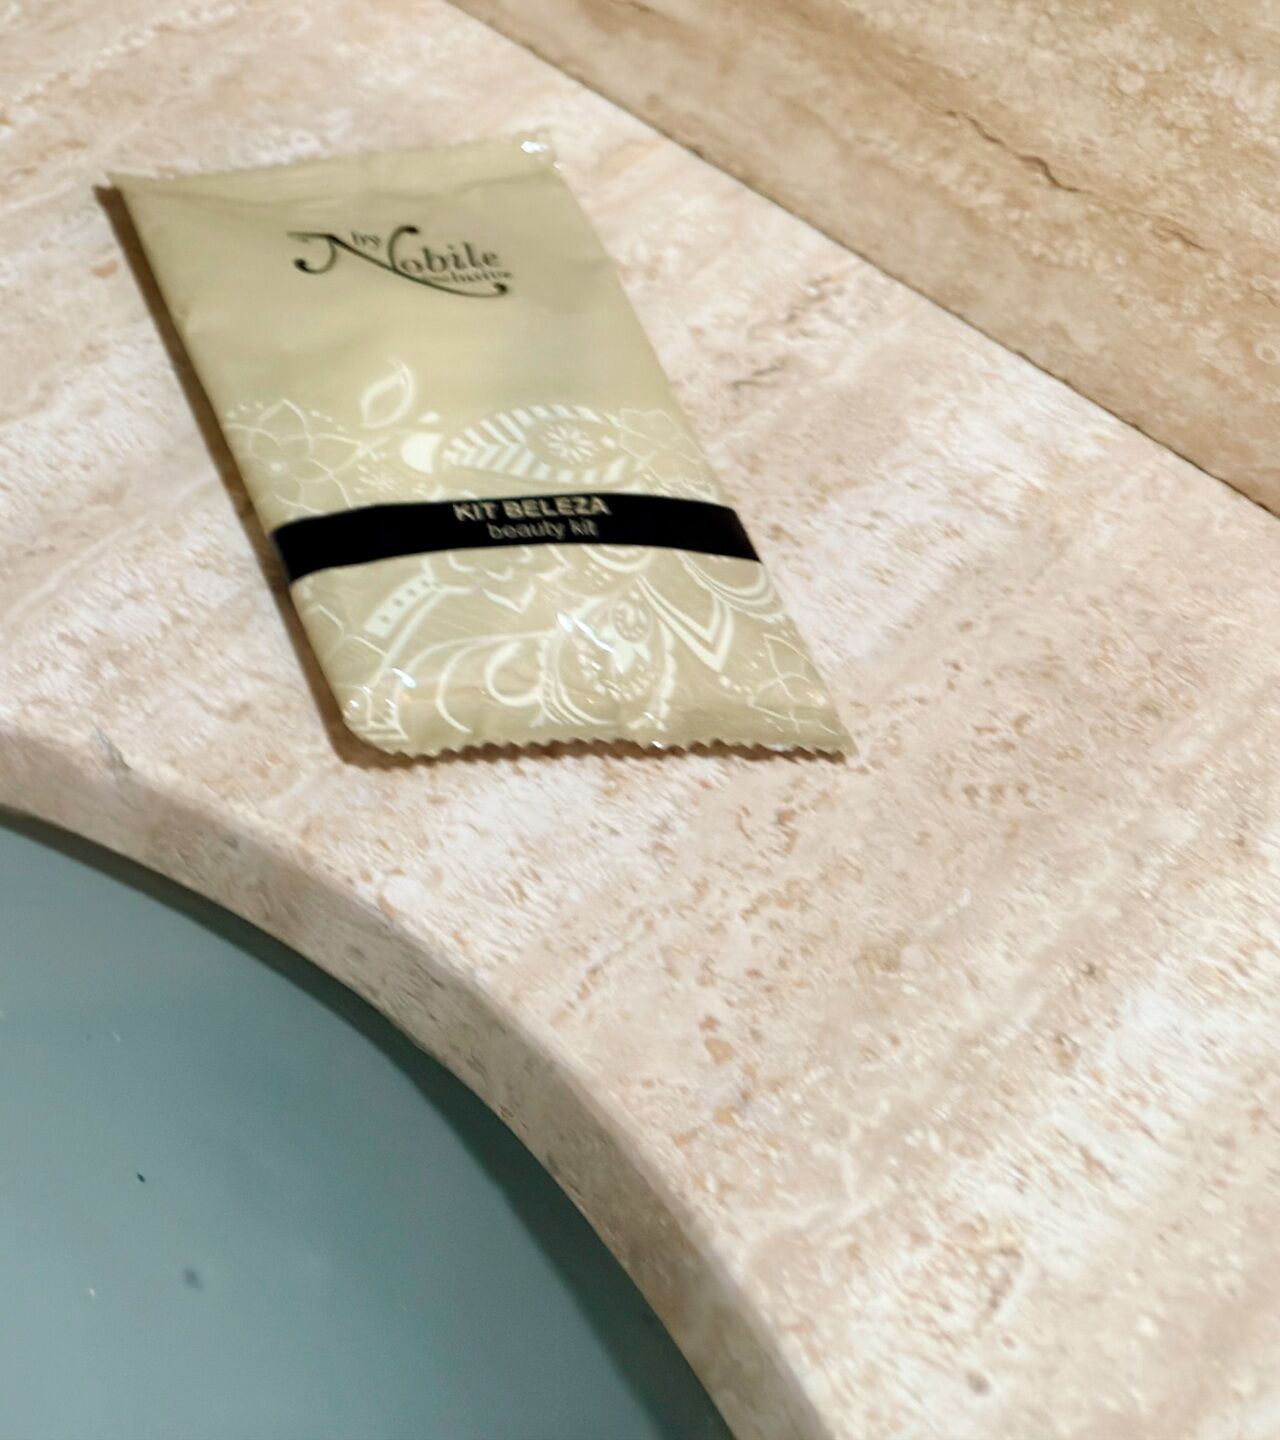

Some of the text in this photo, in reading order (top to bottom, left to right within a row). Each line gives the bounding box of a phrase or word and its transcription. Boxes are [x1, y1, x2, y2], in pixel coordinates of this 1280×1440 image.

[284, 224, 510, 299] Nobile
[452, 495, 614, 523] KIT BELEZA
[486, 516, 600, 541] beauty kit
